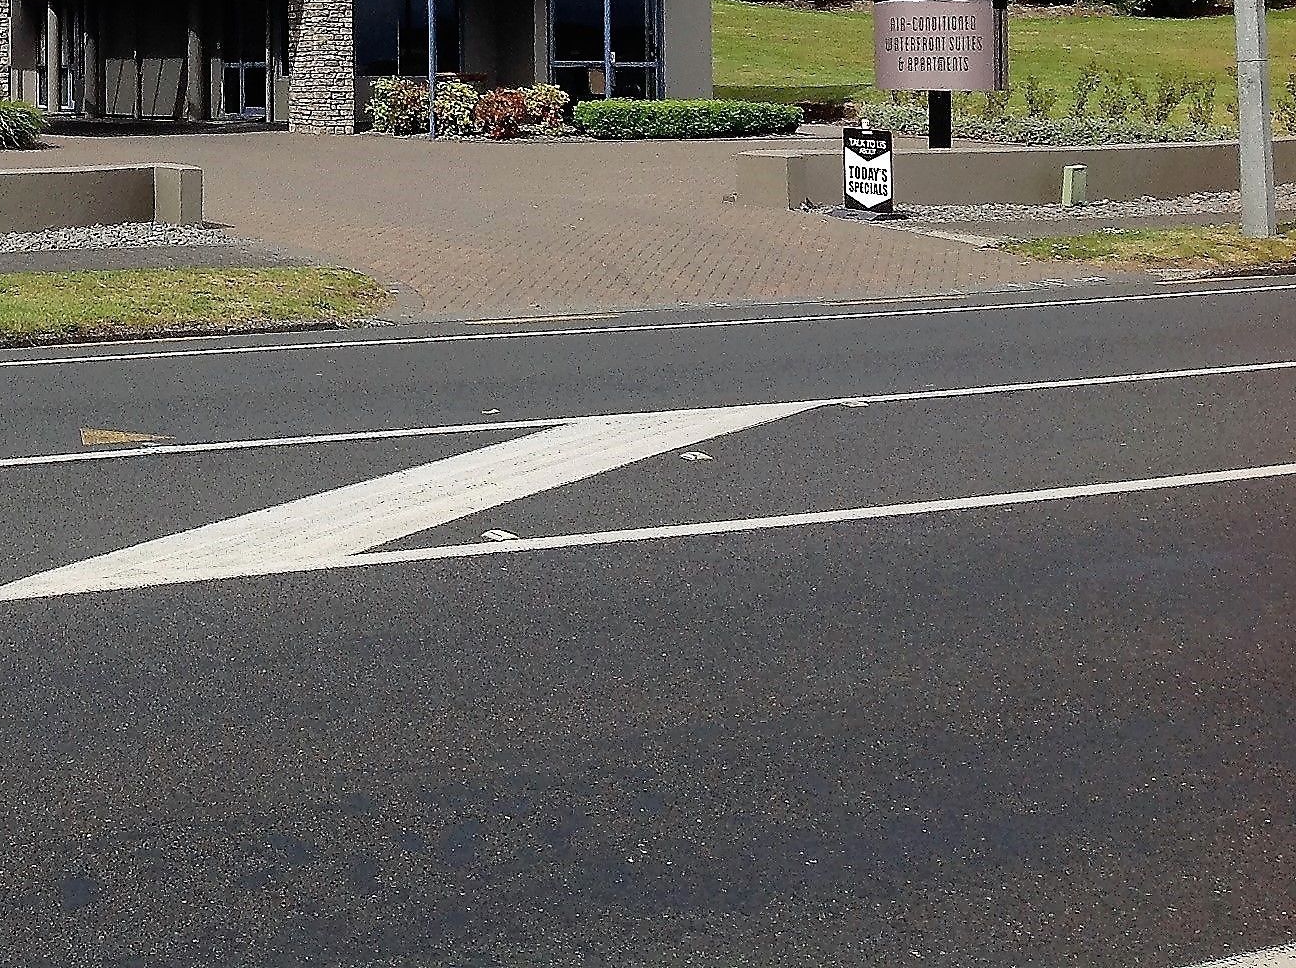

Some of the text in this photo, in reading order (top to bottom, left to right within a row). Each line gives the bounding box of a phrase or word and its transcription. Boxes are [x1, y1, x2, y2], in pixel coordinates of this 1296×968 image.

[949, 35, 984, 52] SUITES
[907, 56, 969, 72] APARTMENTS
[866, 139, 876, 149] TO
[848, 165, 888, 183] TODAY'S
[848, 180, 888, 197] SPECIALS
